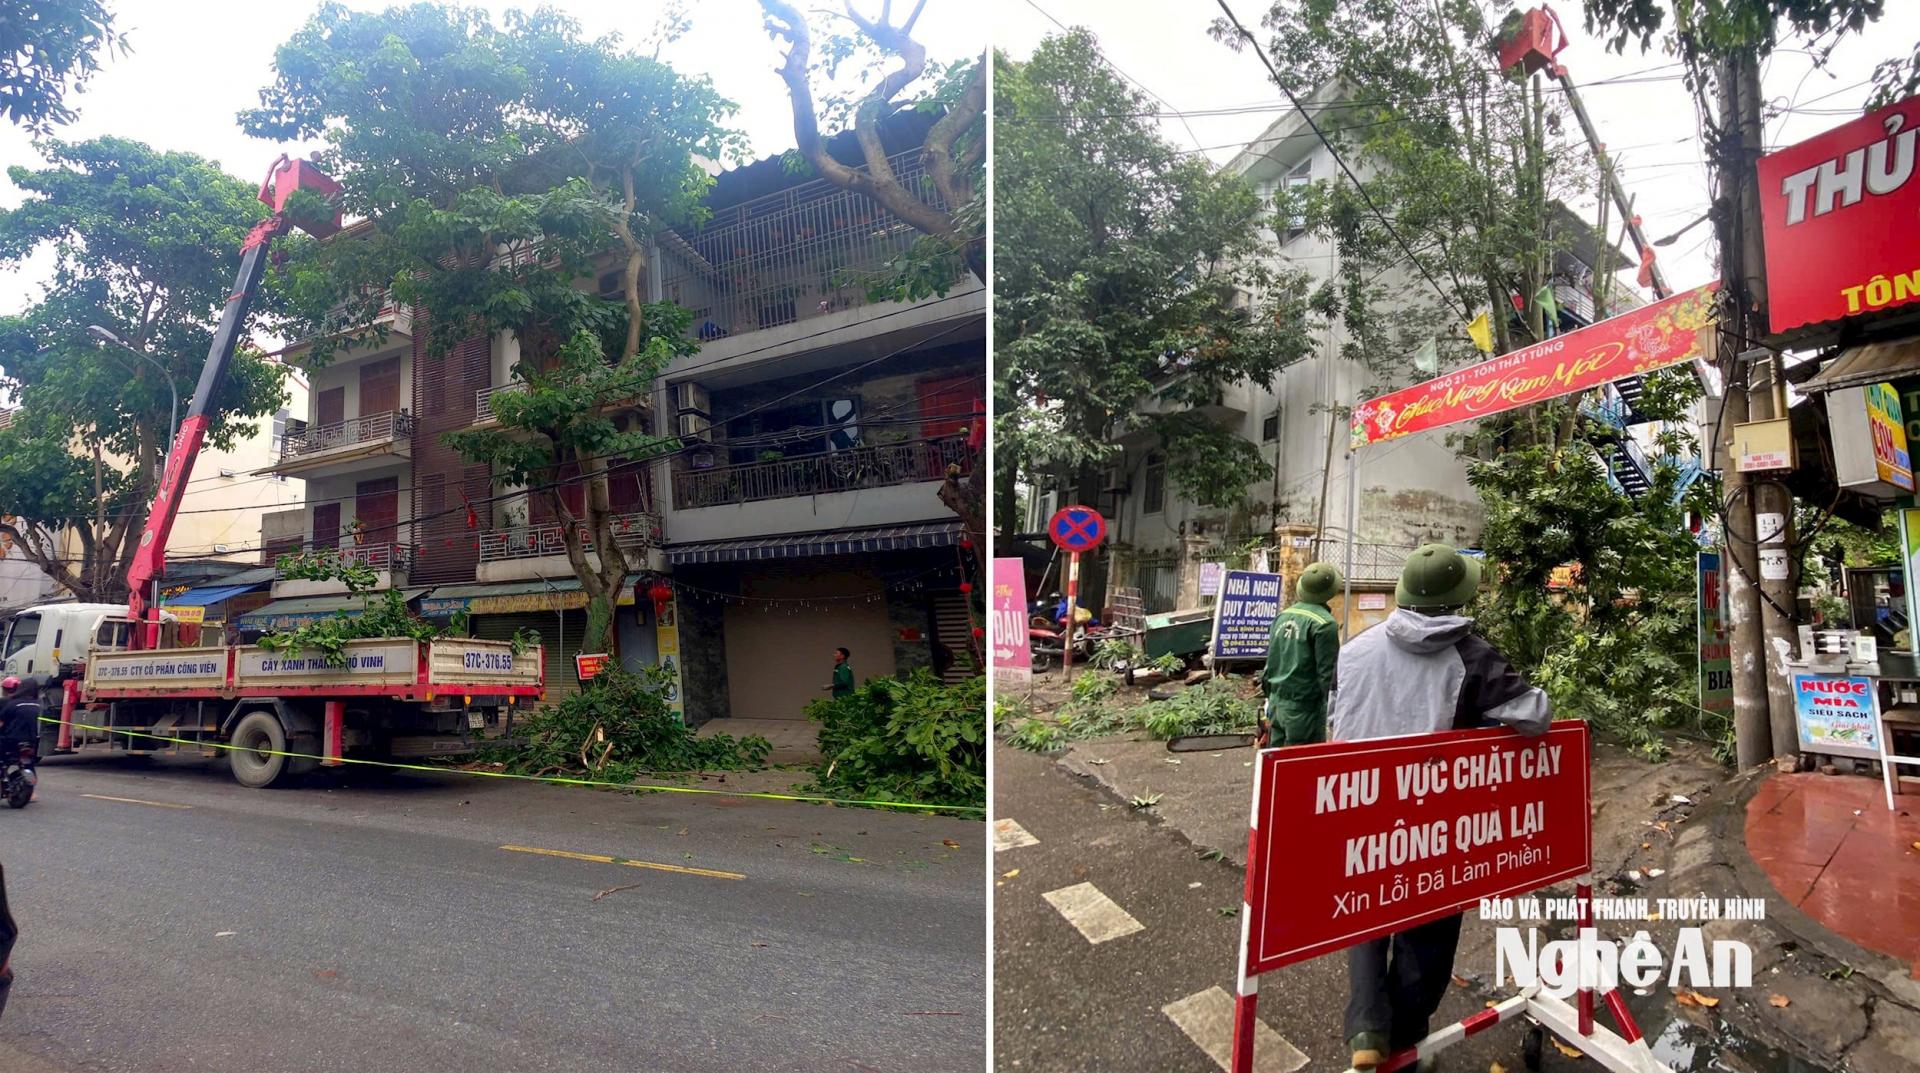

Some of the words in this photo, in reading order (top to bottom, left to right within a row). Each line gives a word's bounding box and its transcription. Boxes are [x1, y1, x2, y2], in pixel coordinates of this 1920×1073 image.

[1781, 113, 1920, 226] THỦ
[1454, 374, 1465, 385] 21
[1473, 363, 1495, 378] TÔN
[1498, 351, 1527, 369] THẤT
[1227, 576, 1250, 595] NHÀ
[1252, 576, 1280, 597] NGHỈ
[1223, 600, 1243, 617] DUY
[130, 665, 142, 676] CTY
[177, 661, 197, 674] CÔNG
[199, 661, 217, 674] VIÊN
[261, 658, 279, 671] CÂY
[281, 657, 305, 670] XANH
[360, 655, 384, 669] VINH
[464, 651, 512, 670] 37C-376.55
[1801, 679, 1866, 696] NƯỚC
[1315, 767, 1380, 815] KHU
[1396, 759, 1448, 806] VỰC
[1453, 745, 1516, 792] CHẶT
[1520, 741, 1562, 779] CÂY
[1345, 819, 1448, 878] KHÔNG
[1455, 809, 1503, 853] QUA
[1511, 801, 1544, 840] LẠI
[1332, 892, 1370, 919] Xin
[1379, 874, 1409, 906] Lỗi
[1417, 871, 1445, 895] Đã
[1452, 859, 1490, 886] Làm
[1496, 842, 1542, 875] Phiền
[1546, 845, 1551, 865] !
